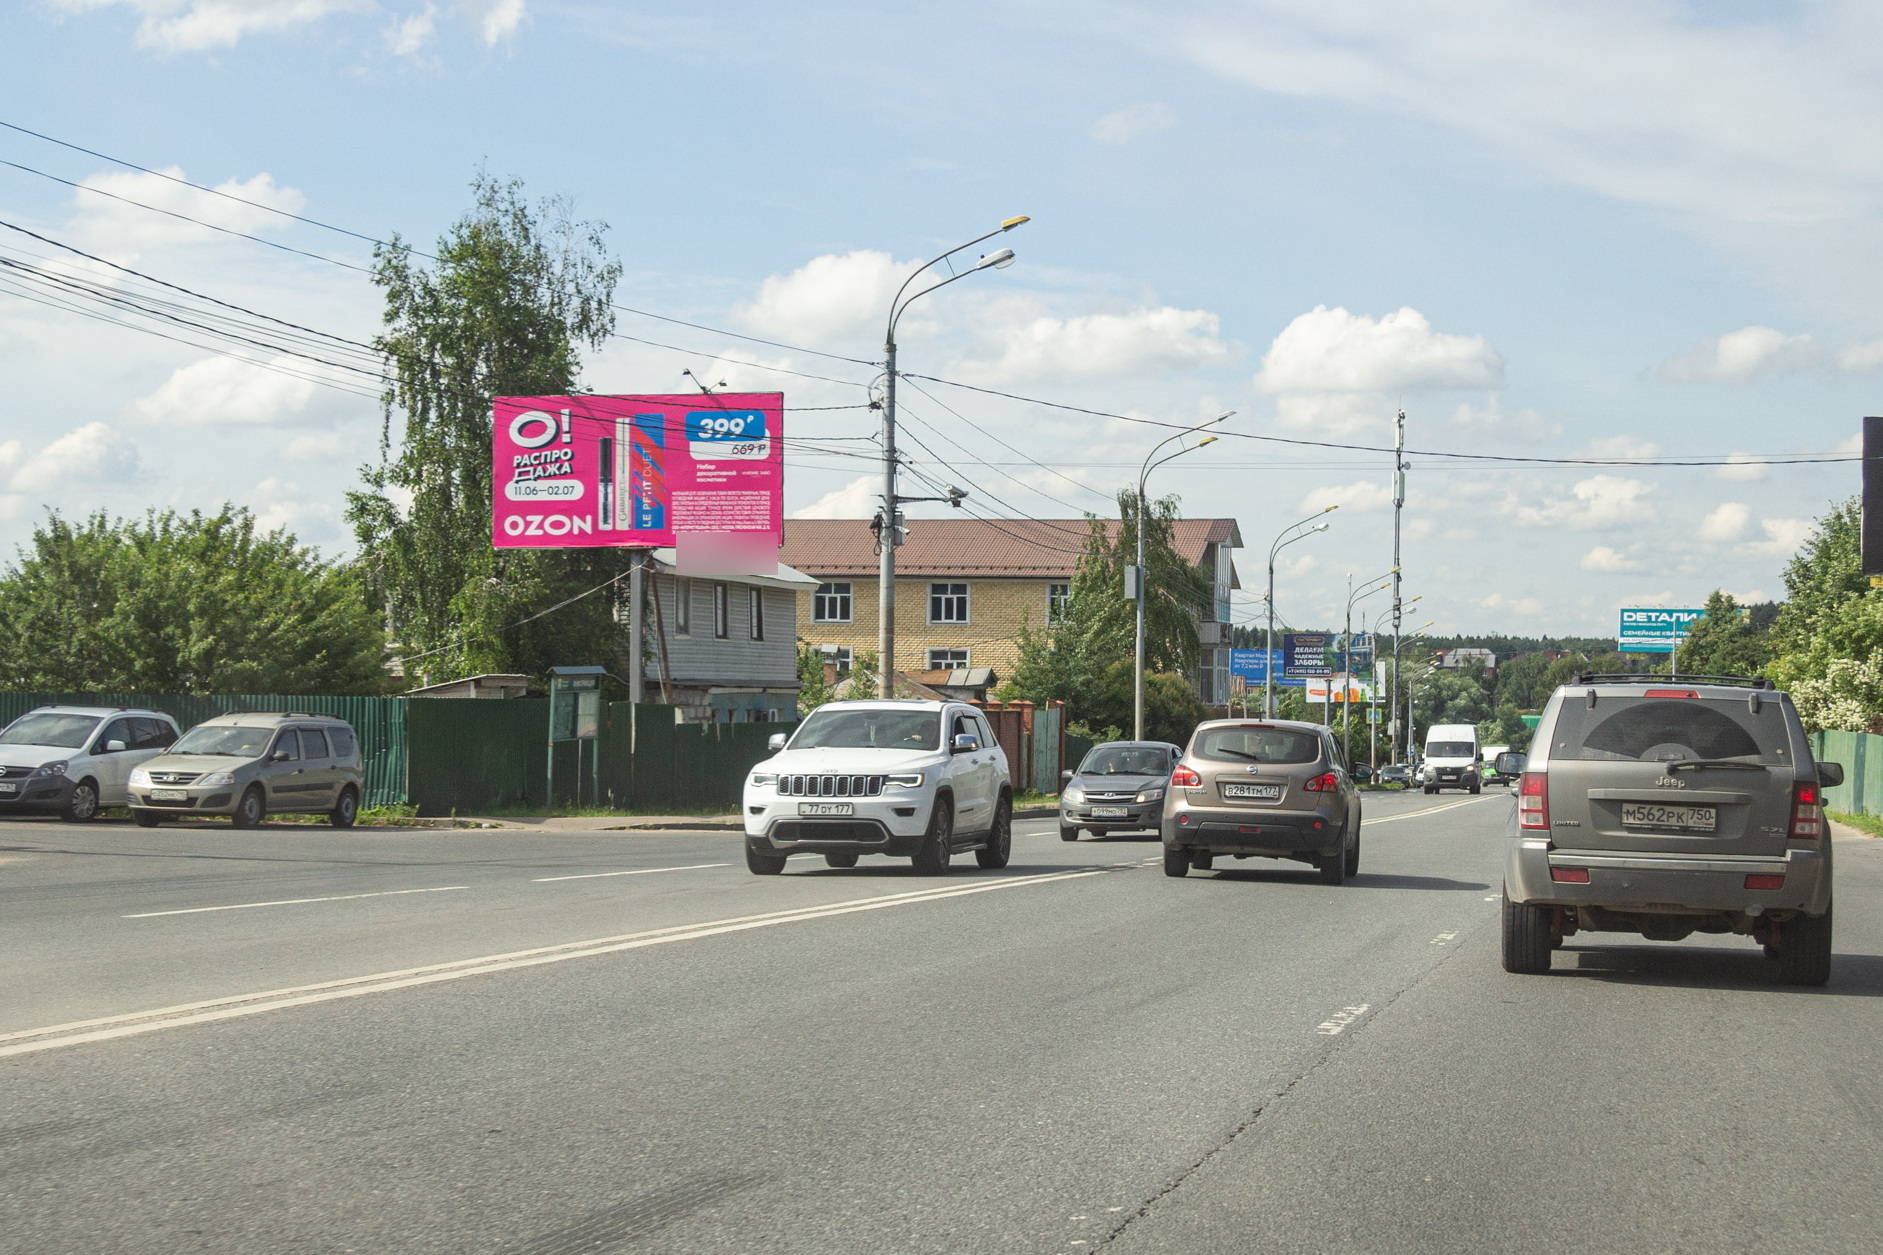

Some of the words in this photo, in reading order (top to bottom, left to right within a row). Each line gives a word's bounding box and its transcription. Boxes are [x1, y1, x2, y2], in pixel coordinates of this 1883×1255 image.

[513, 448, 574, 467] РАСПРО
[512, 462, 574, 484] ДАЖА
[504, 514, 592, 536] OZON
[642, 513, 652, 527] LE
[1656, 776, 1685, 788] Jeep
[808, 804, 819, 813] 77
[834, 804, 850, 813] 177
[1688, 808, 1711, 821] 750
